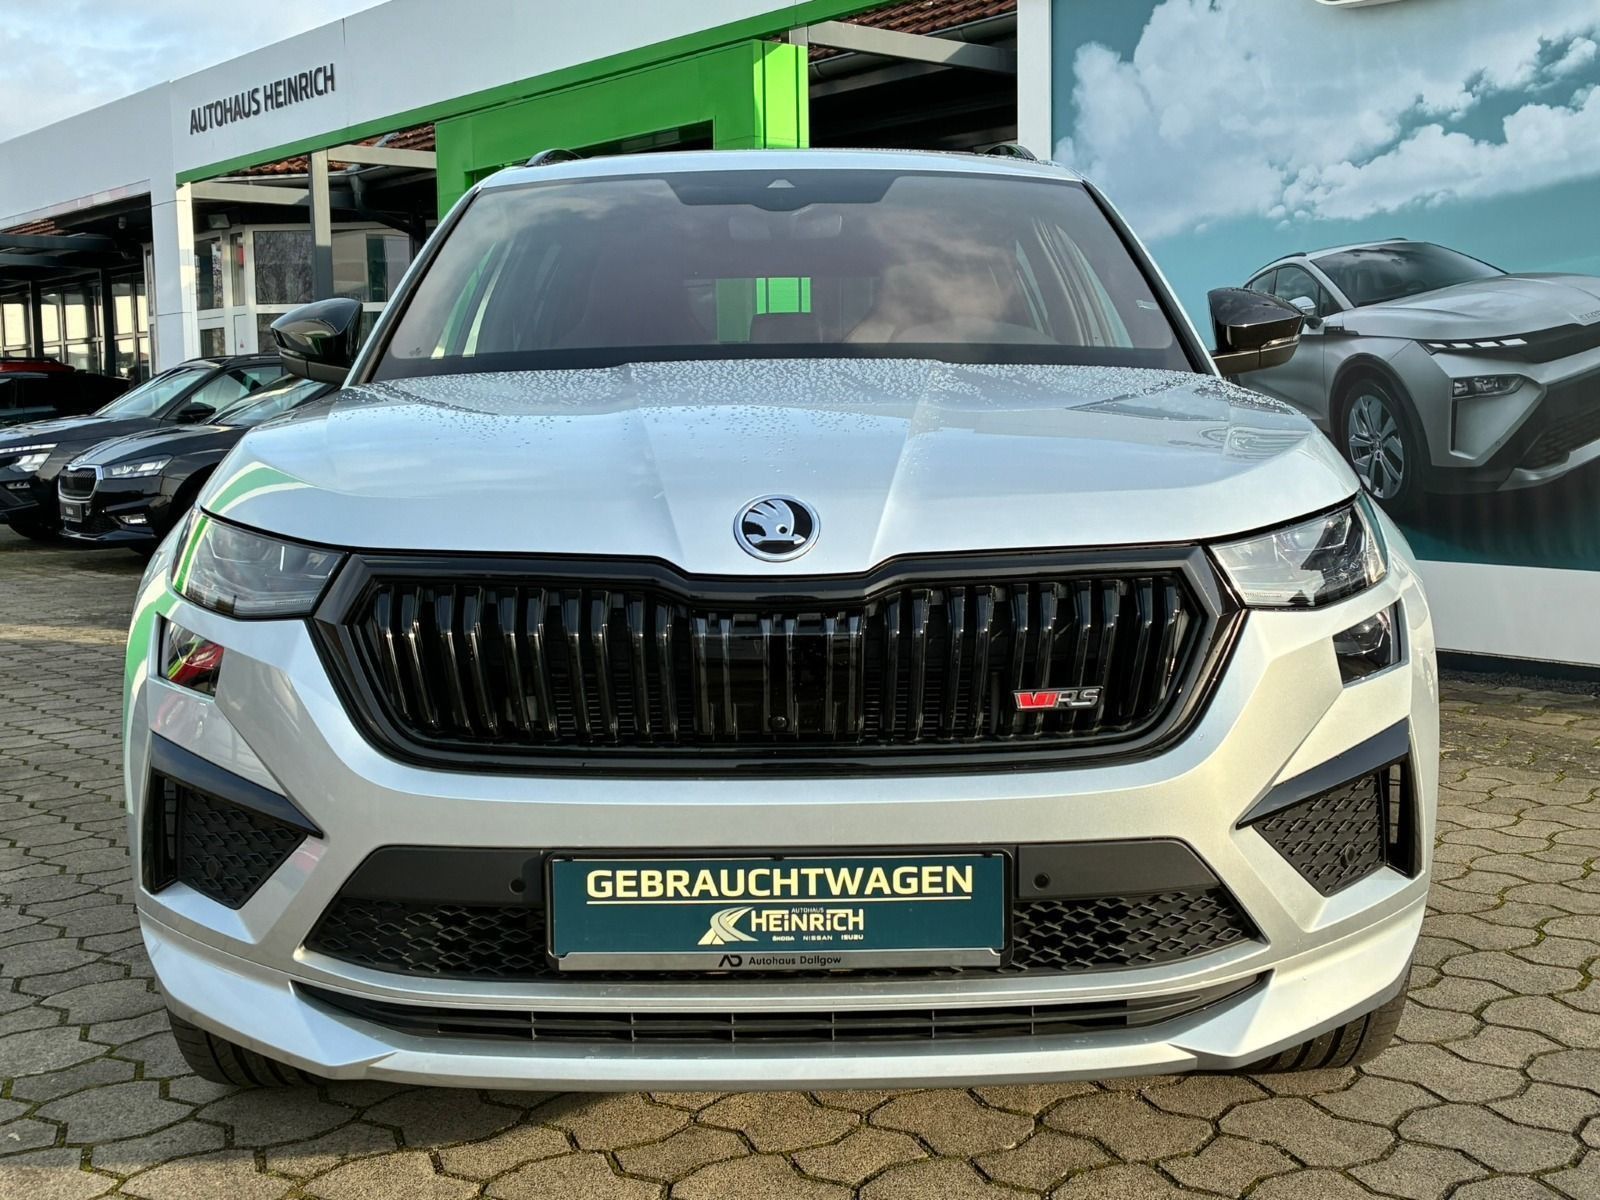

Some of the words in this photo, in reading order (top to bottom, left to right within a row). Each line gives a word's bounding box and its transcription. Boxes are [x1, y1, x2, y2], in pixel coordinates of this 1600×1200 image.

[190, 87, 261, 135] AUTOHAUS
[263, 63, 335, 112] HEINRICH
[586, 865, 973, 898] GEBRAUCHTWAGEN
[749, 956, 796, 966] Autohaus
[800, 955, 842, 967] Dallgow
